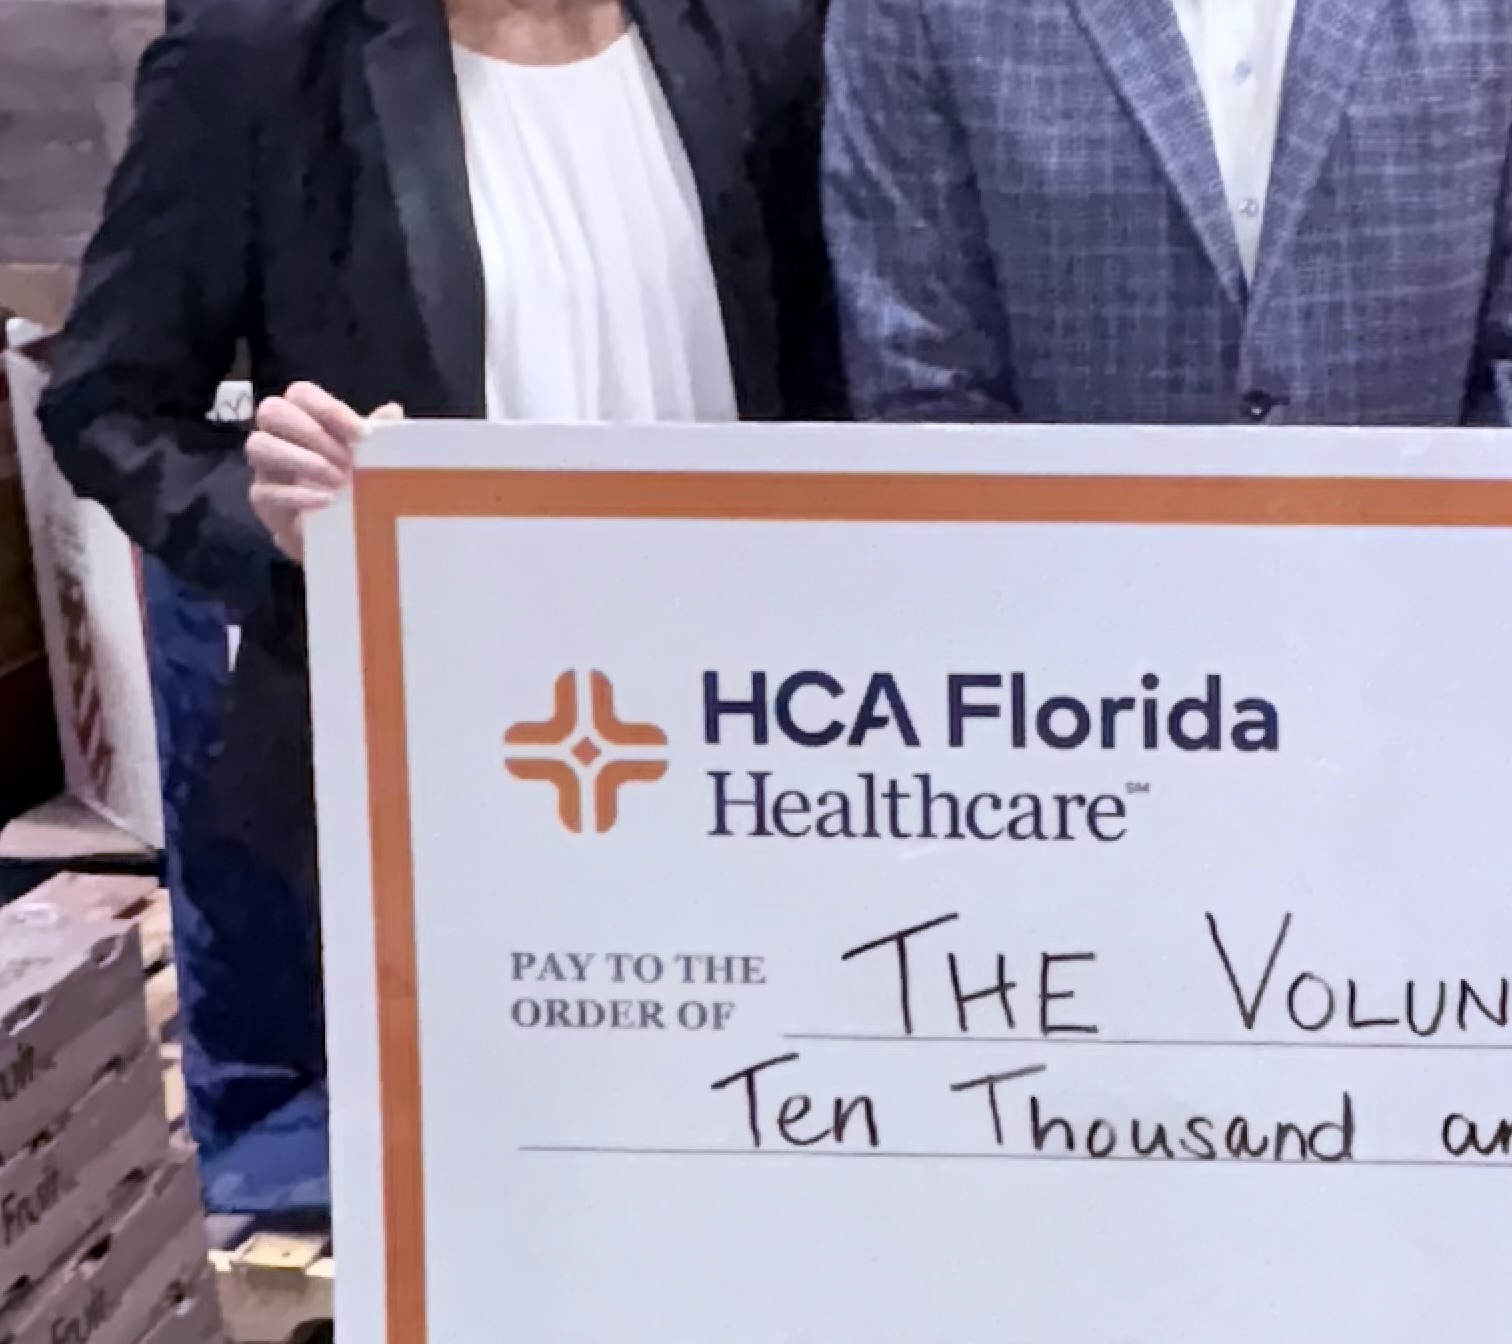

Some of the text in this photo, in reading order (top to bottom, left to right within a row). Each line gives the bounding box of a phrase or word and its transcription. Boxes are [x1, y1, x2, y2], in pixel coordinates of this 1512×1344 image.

[702, 669, 1280, 753] HCA Florida
[706, 770, 1127, 842] Healthcare
[510, 952, 766, 984] PAY TO THE
[841, 912, 1100, 1035] THE
[510, 998, 735, 1030] ORDER OF
[710, 1052, 880, 1148] Ten
[949, 1064, 1358, 1162] Thousand
